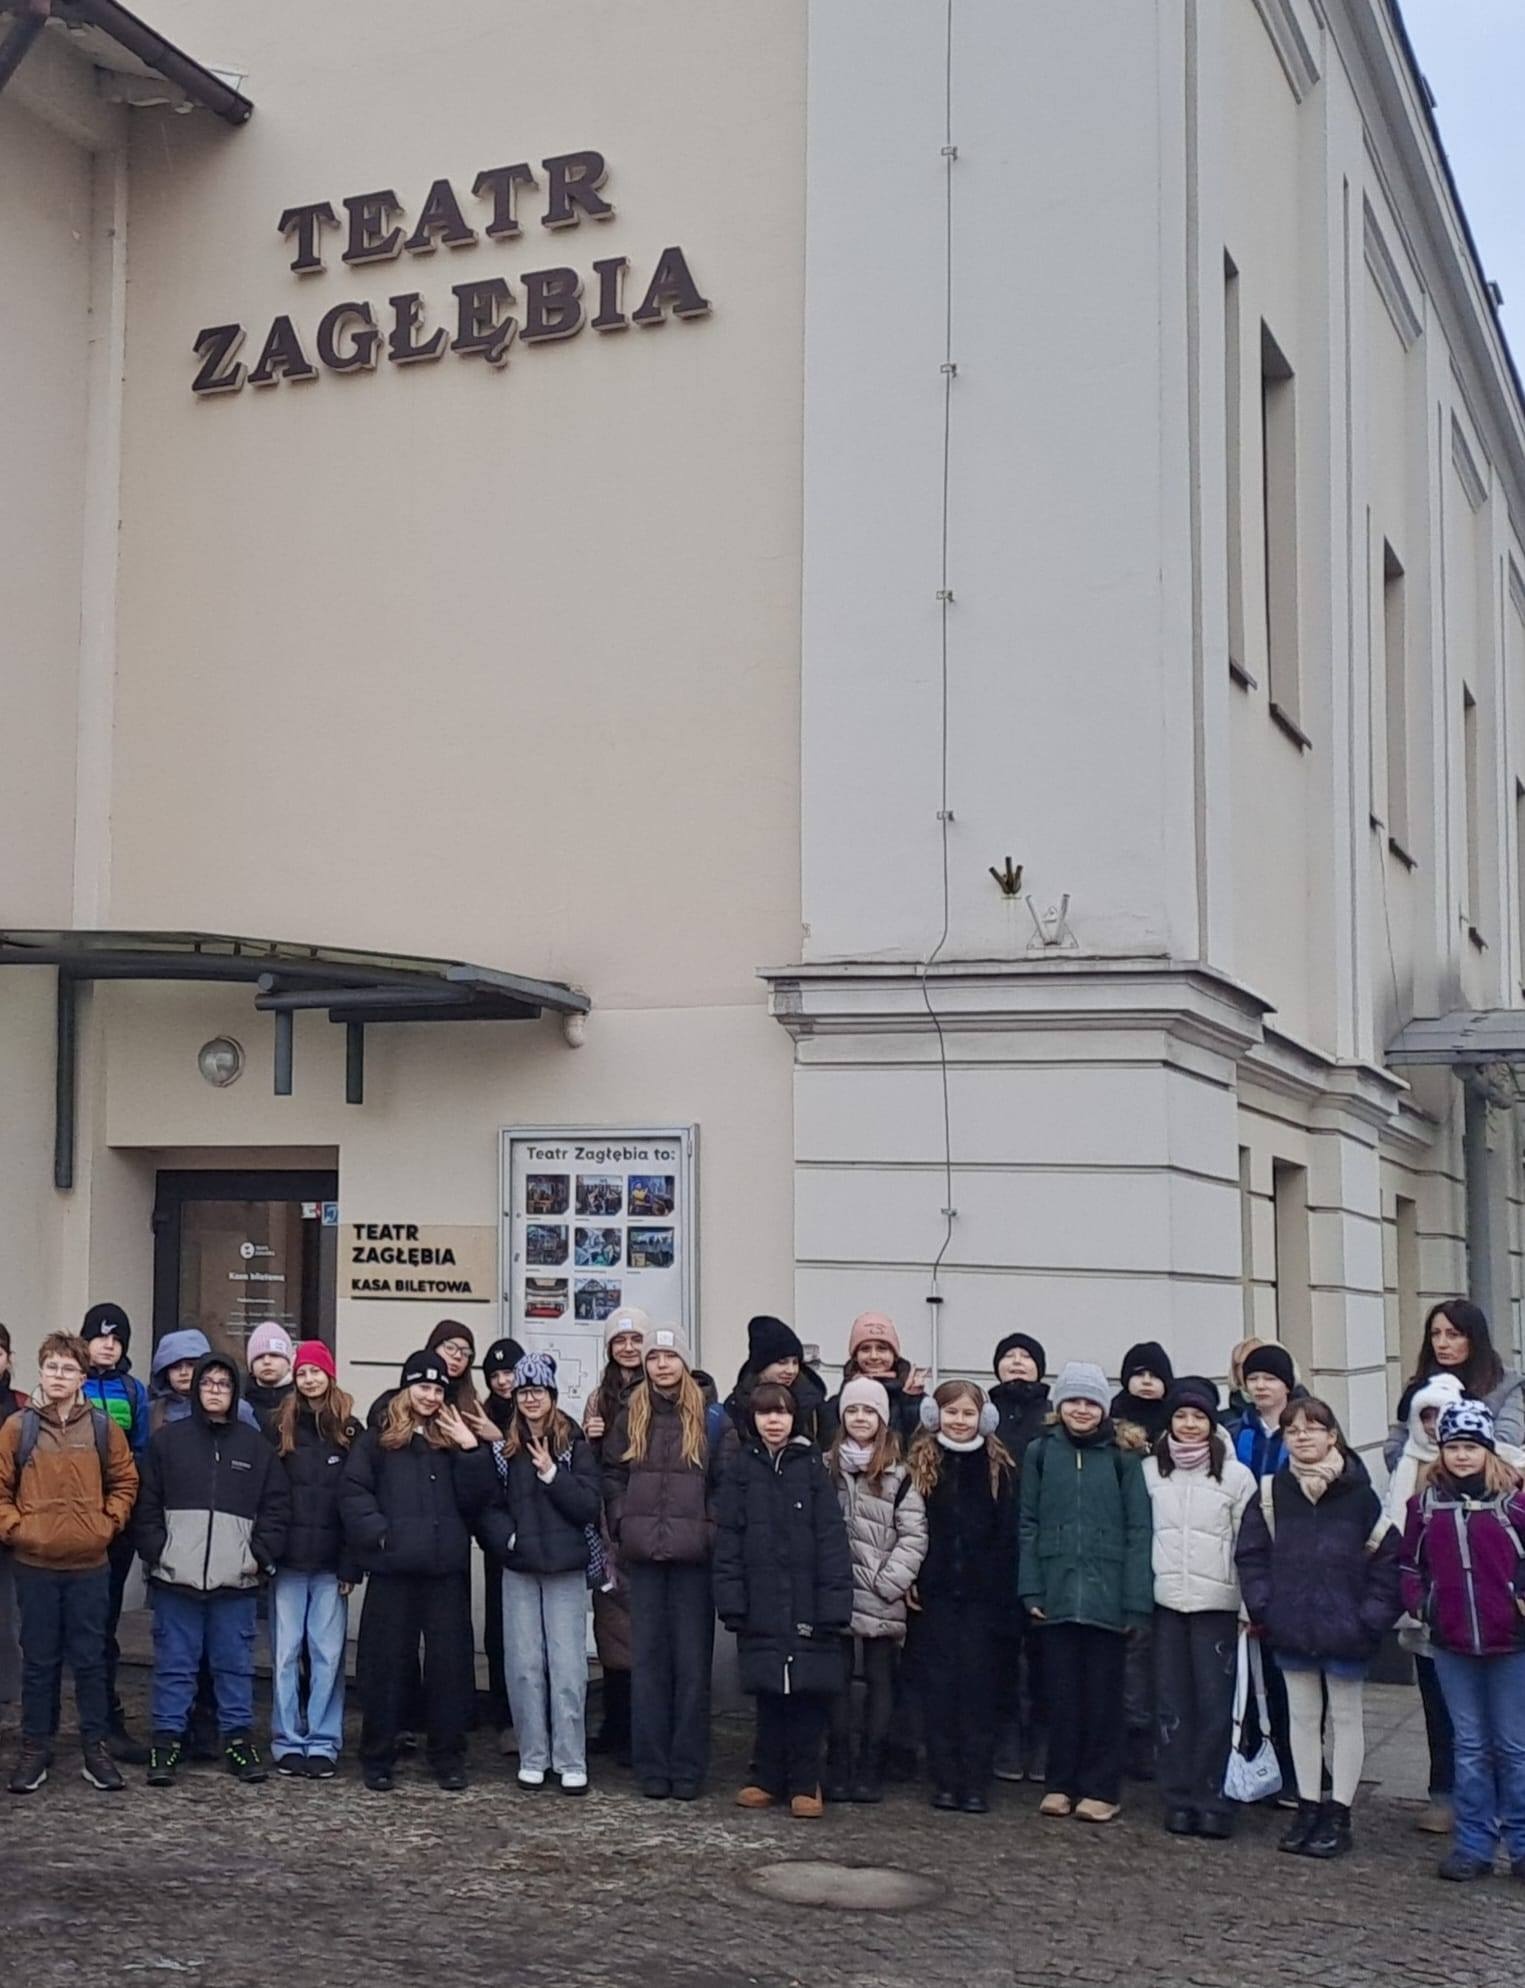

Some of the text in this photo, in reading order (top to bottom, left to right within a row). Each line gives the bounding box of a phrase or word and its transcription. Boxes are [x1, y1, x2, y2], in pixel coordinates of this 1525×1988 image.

[279, 150, 615, 274] TEATR
[192, 246, 712, 395] ZAGŁĘBIA
[527, 1146, 676, 1164] Teatr Zagłębia to:
[353, 1223, 419, 1241] TEATR
[352, 1246, 456, 1267] ZAGŁĘBIA
[352, 1278, 472, 1293] KASA BILETOWA
